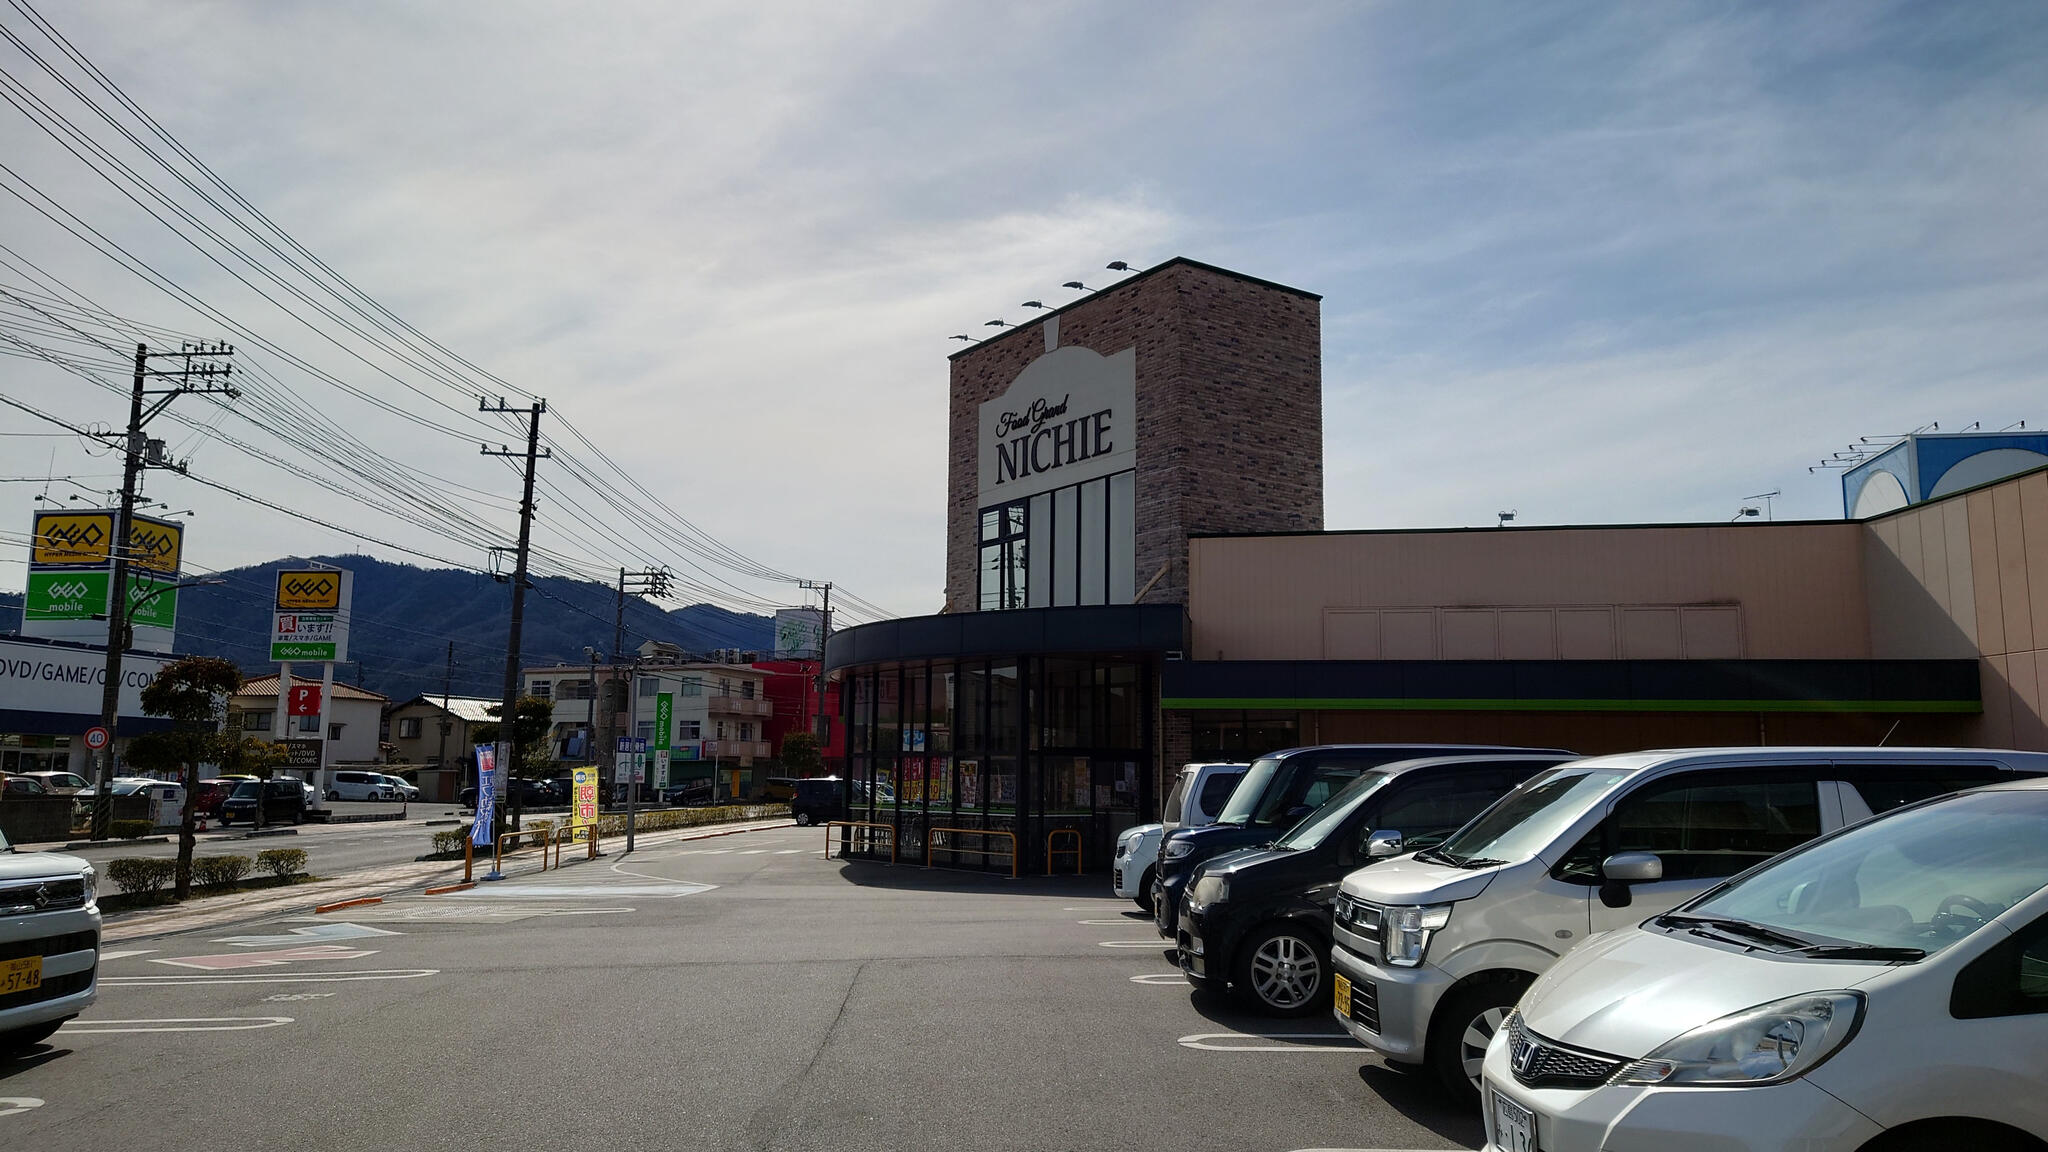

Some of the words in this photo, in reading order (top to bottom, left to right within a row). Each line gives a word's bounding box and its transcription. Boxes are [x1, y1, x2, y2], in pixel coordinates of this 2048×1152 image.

[996, 407, 1031, 437] Food
[1031, 394, 1069, 433] Grand
[996, 409, 1113, 484] NICHIE
[42, 523, 104, 547] GEO
[48, 582, 88, 599] GEO
[284, 579, 333, 596] GEO
[50, 600, 83, 612] mobile
[280, 647, 300, 656] GEO
[301, 648, 328, 657] mobile
[299, 689, 309, 701] P
[90, 733, 103, 744] 40
[658, 720, 668, 745] mobile
[7, 969, 39, 990] 57-48
